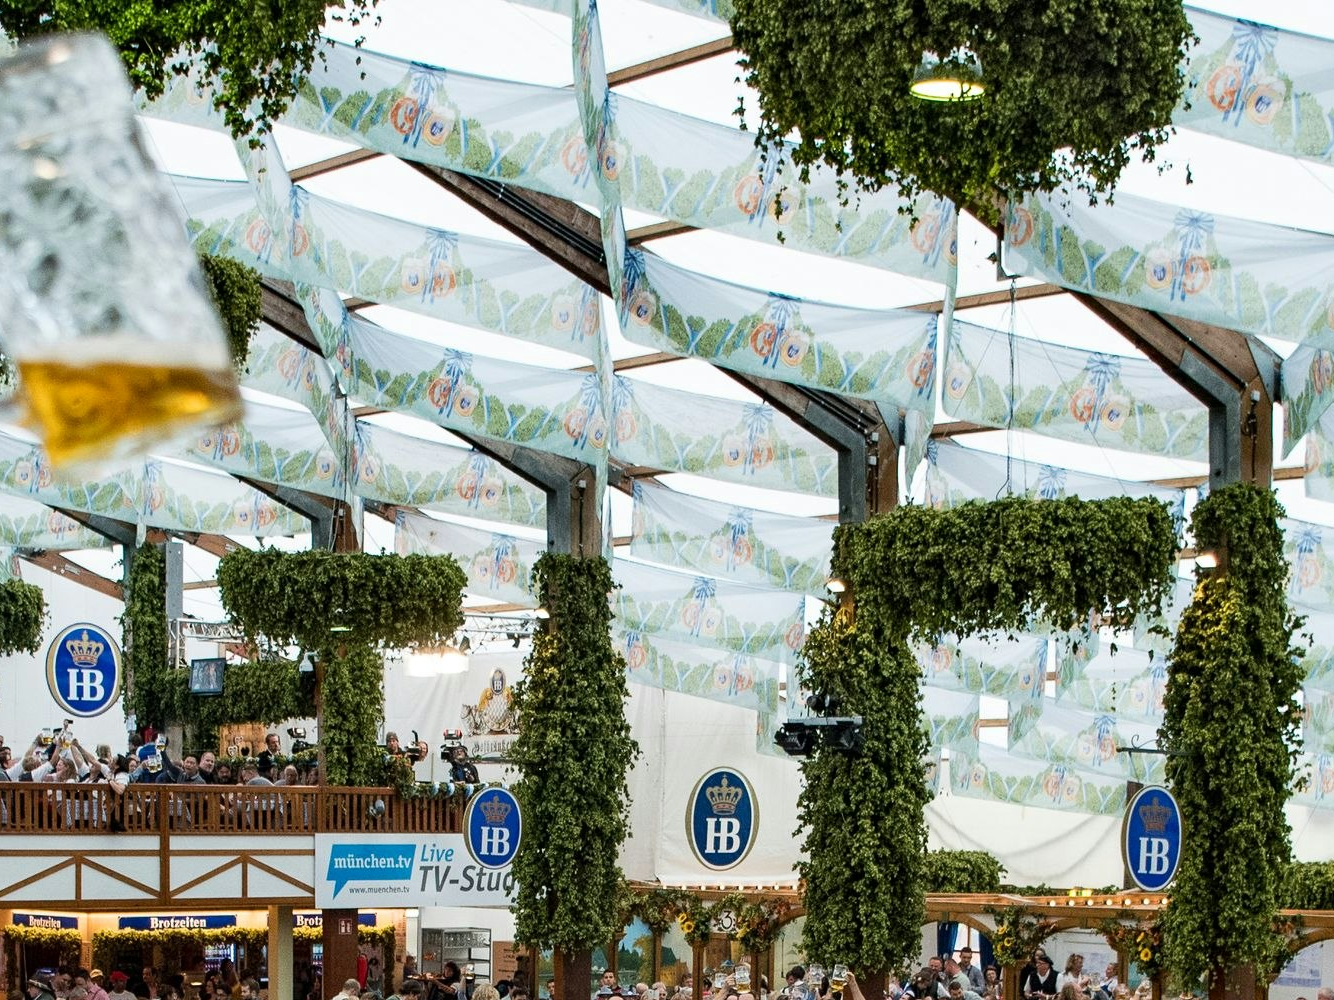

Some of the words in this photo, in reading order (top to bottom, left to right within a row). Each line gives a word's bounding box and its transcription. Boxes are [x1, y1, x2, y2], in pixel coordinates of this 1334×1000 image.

[67, 668, 105, 701] HB
[479, 826, 510, 856] HB
[704, 817, 741, 854] HB
[334, 853, 412, 869] münchen.tv
[420, 843, 454, 862] Live
[1137, 836, 1170, 875] HB
[349, 885, 410, 894] www.muenchen.tv
[29, 916, 61, 929] Brotzeiten
[150, 916, 207, 929] Brotzeiten
[722, 910, 733, 930] 3
